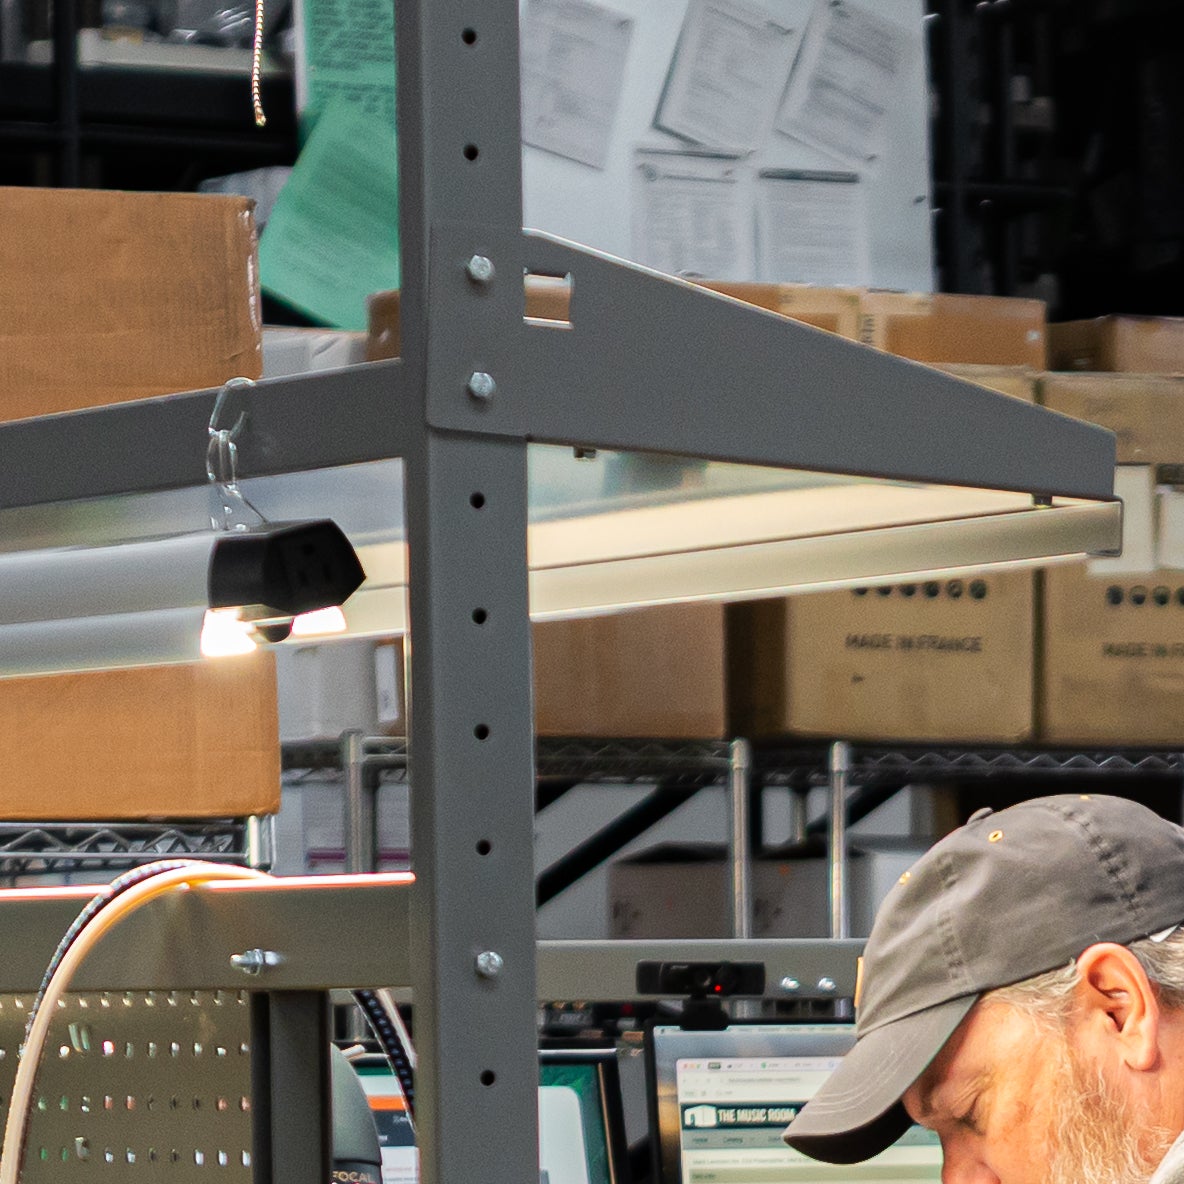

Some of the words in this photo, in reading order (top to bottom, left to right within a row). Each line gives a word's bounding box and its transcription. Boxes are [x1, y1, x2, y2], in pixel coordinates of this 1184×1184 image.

[917, 634, 983, 653] FRANCE
[717, 1109, 736, 1123] THE
[737, 1108, 767, 1123] MUSIC
[768, 1108, 796, 1122] ROOM
